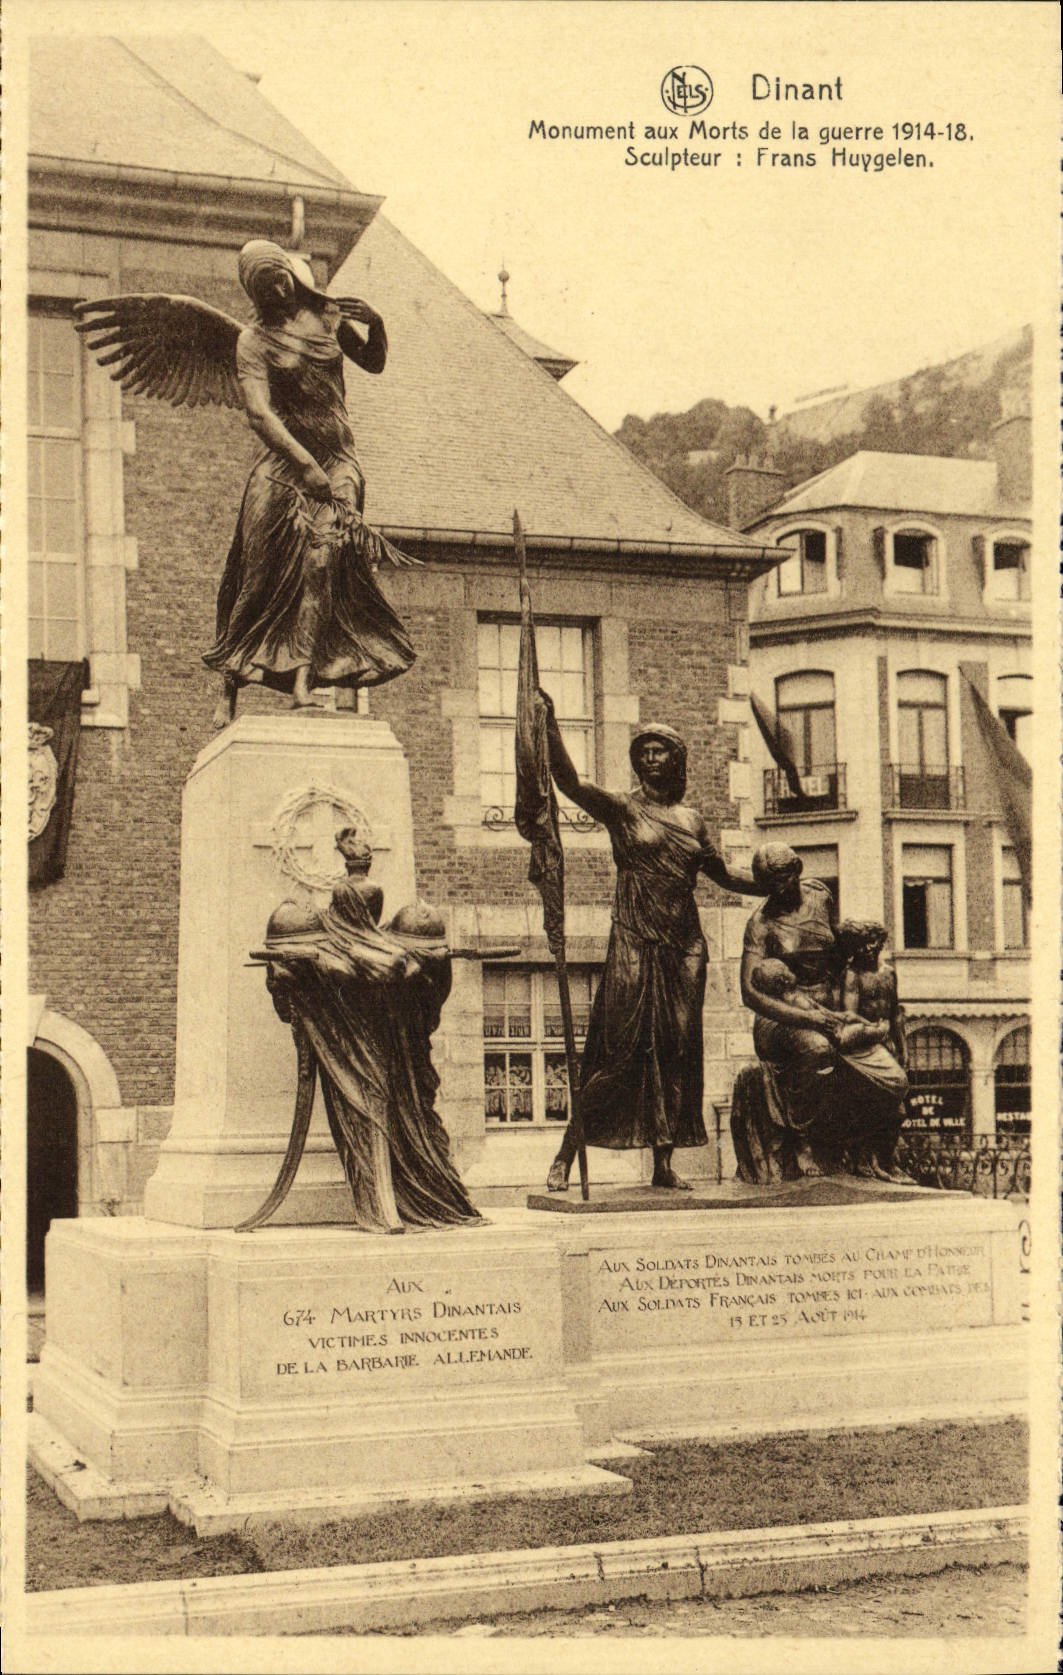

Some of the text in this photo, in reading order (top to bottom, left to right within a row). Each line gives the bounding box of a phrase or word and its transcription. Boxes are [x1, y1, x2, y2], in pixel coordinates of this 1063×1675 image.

[308, 1327, 499, 1349] VICTIMES INNOCENTES
[276, 1362, 299, 1376] DE
[303, 1361, 328, 1374] LA
